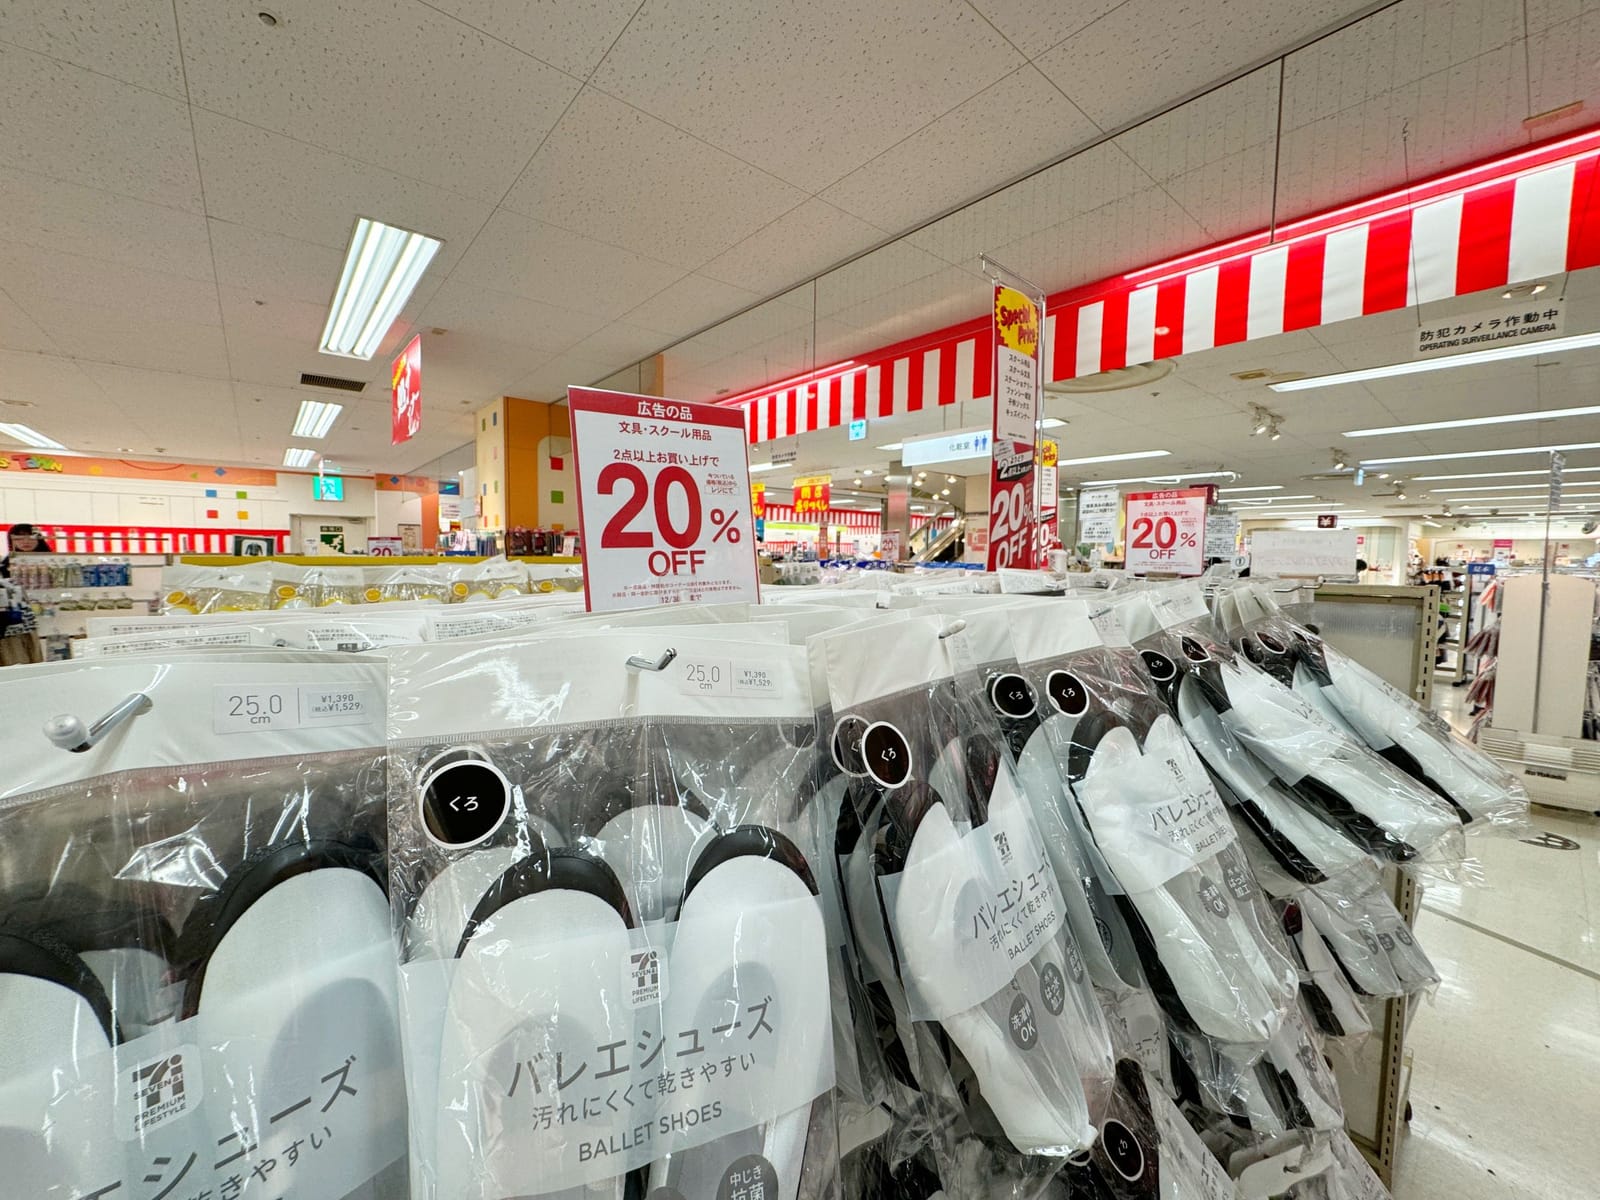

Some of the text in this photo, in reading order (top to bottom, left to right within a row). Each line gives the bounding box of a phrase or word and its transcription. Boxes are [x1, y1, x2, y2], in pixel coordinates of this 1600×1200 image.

[1420, 308, 1559, 342] 防犯カメラ作動中
[1419, 323, 1557, 352] OPERATING SURVEILLANCE CAMERA
[637, 401, 693, 421] 広告の品
[618, 421, 712, 442] 文具・スクール用品
[613, 448, 719, 468] 2点以上お買い上げで
[996, 527, 1028, 568] OFF
[1149, 549, 1176, 560] OFF
[648, 550, 706, 577] OFF
[686, 664, 720, 682] 25.0
[1151, 659, 1163, 669] くろ
[743, 670, 766, 679] ¥1,390
[321, 694, 354, 704] ¥1,390
[1009, 691, 1024, 701] くろ
[1062, 687, 1076, 699] くろ
[229, 694, 282, 716] 25.0
[250, 716, 271, 724] cm
[881, 747, 896, 762] くろ
[449, 796, 479, 812] くろ
[1007, 910, 1057, 960] BALLET SHOES
[632, 985, 658, 996] PREMIUM
[632, 992, 659, 1004] LIFESTYLE
[1021, 1022, 1036, 1042] OK
[507, 995, 773, 1098] バレエシューズ
[532, 1052, 756, 1131] 汚れにくくて乾きやすい
[134, 1094, 186, 1123] PREMIUM
[135, 1102, 187, 1132] LFESTYLE
[579, 1100, 723, 1162] BALLET SHOES
[1118, 1139, 1128, 1156] くろ
[730, 1165, 762, 1186] 中じき
